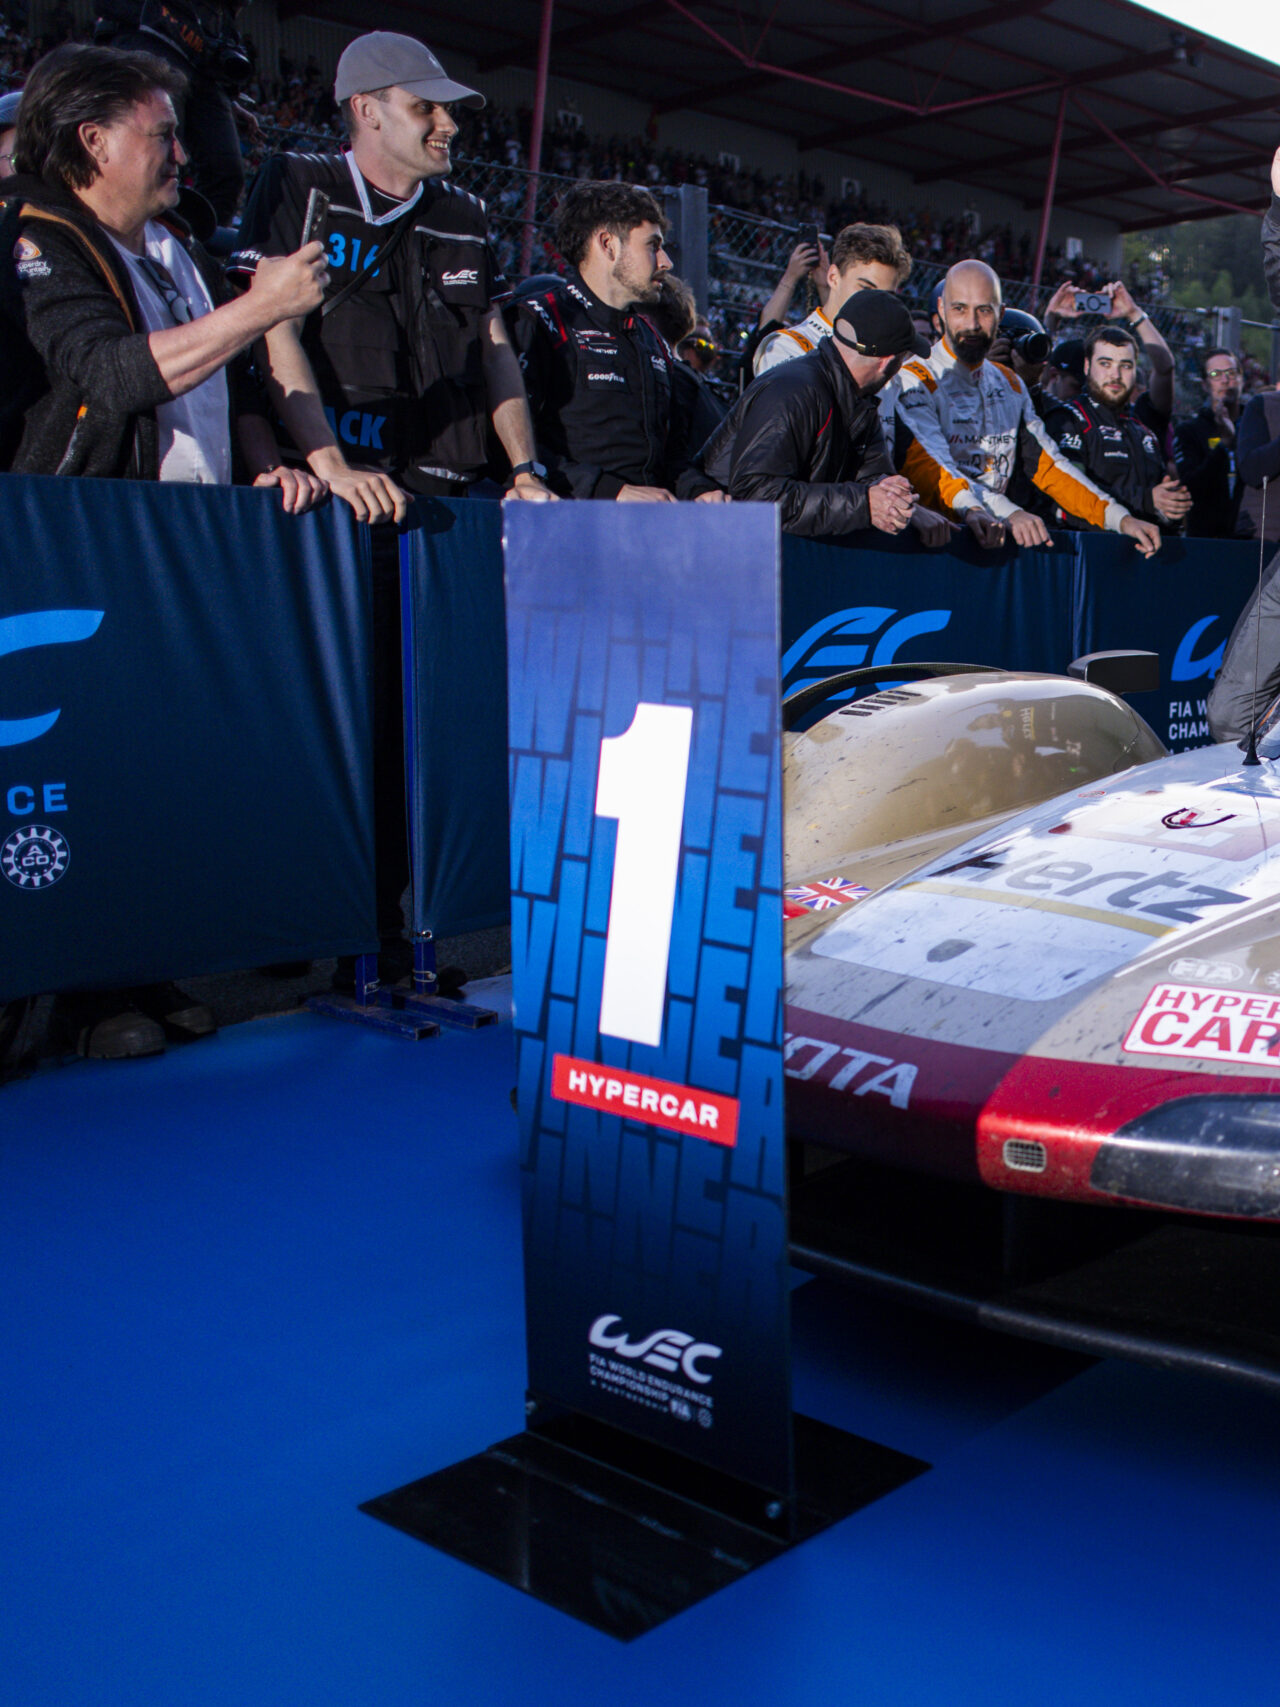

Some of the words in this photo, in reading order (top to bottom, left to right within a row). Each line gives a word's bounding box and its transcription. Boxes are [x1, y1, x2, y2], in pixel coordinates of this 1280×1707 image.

[1169, 700, 1192, 718] FIA
[595, 702, 693, 1047] 1
[926, 849, 1253, 924] Hertz
[1172, 960, 1234, 981] FIA
[567, 1069, 720, 1130] HYPERCAR
[784, 1032, 919, 1111] OTA
[589, 1313, 723, 1384] WEC
[590, 1365, 670, 1401] CHAMPIONSHIP
[608, 1360, 647, 1382] WORLD
[647, 1374, 713, 1408] ENDURANCE
